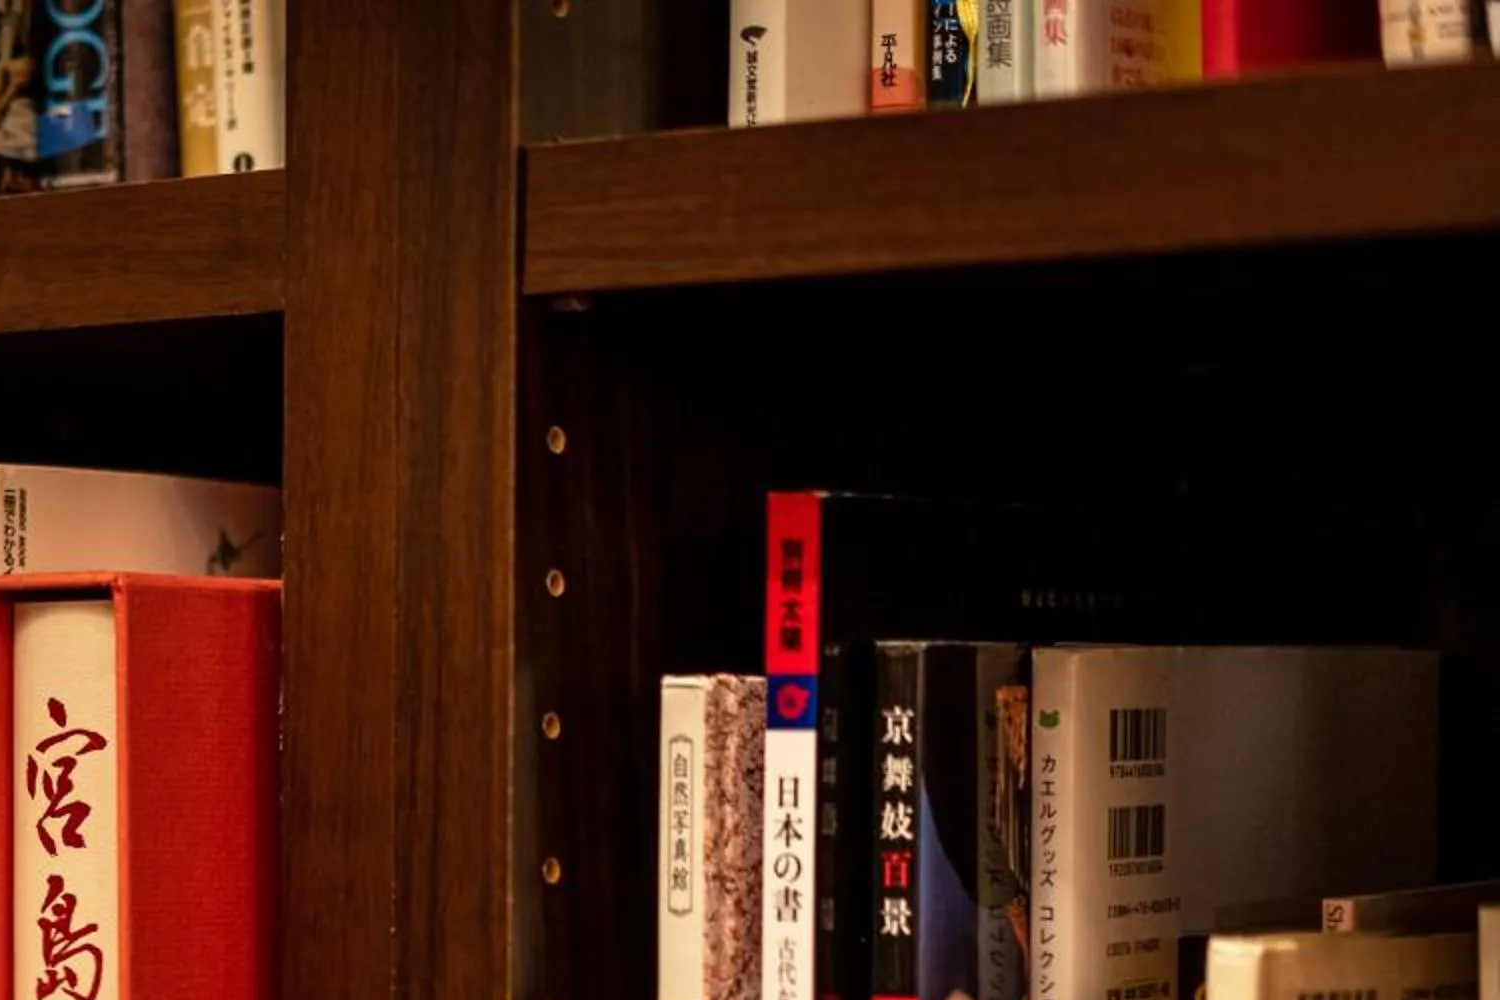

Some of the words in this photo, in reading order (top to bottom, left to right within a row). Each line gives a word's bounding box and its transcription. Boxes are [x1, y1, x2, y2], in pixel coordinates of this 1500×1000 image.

[881, 33, 897, 87] 平凡社
[773, 776, 804, 924] 日本の書
[881, 705, 914, 937] 京舞妓百景
[1038, 754, 1058, 888] カエルグッズ
